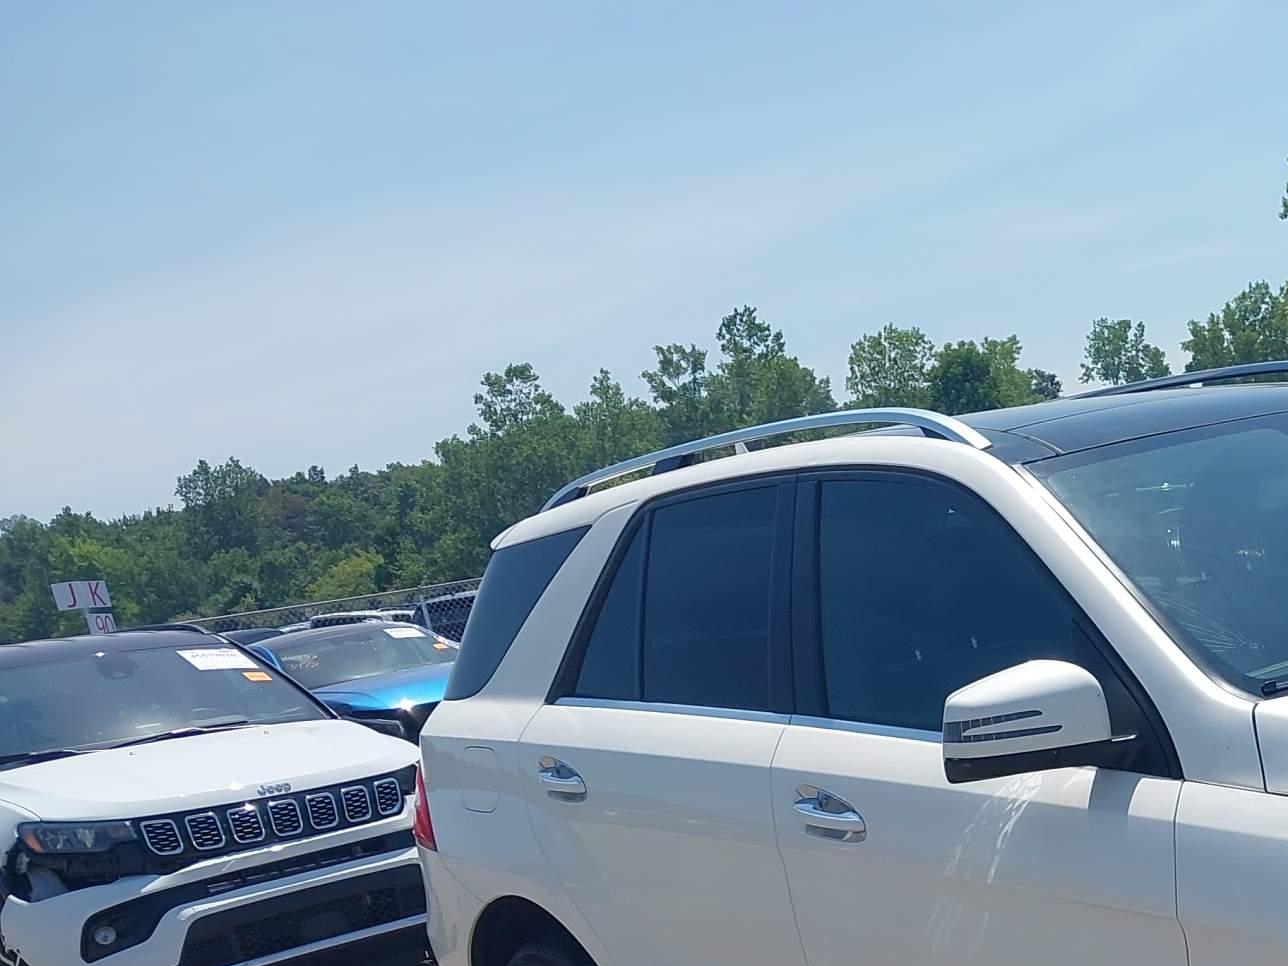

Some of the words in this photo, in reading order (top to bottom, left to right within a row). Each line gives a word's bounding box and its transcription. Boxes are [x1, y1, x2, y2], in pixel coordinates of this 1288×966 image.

[67, 583, 77, 608] J
[88, 582, 107, 606] K
[256, 782, 292, 797] Jeep
